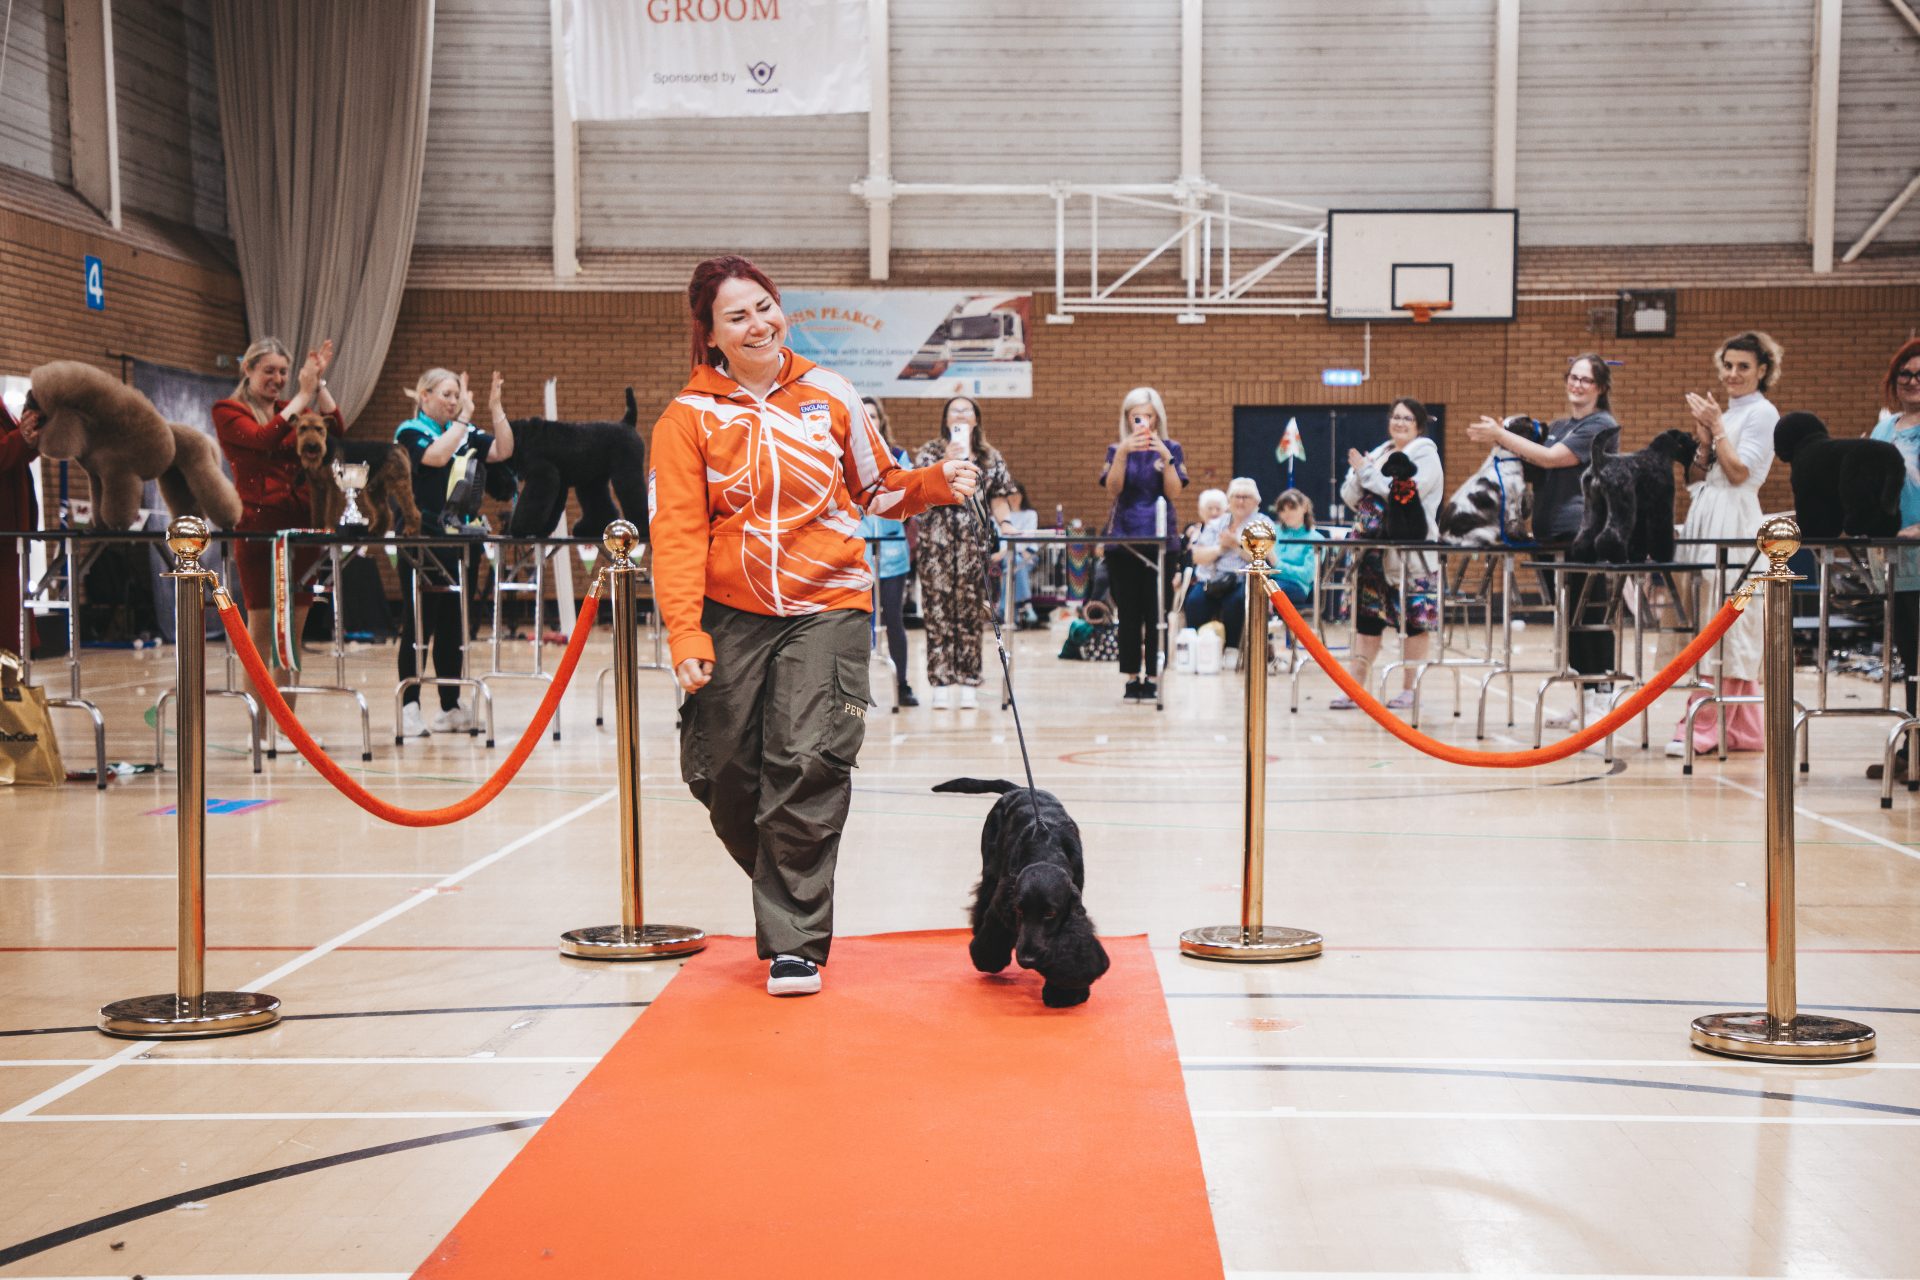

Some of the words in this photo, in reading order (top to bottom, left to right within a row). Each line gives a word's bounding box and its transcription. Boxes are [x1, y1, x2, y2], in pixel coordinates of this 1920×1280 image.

[646, 0, 781, 24] GROOM
[653, 71, 719, 86] Sponsored
[721, 71, 736, 86] by
[88, 262, 103, 305] 4
[821, 306, 885, 334] PEARCE
[861, 347, 884, 356] Celtic
[800, 403, 830, 413] ENGLAND
